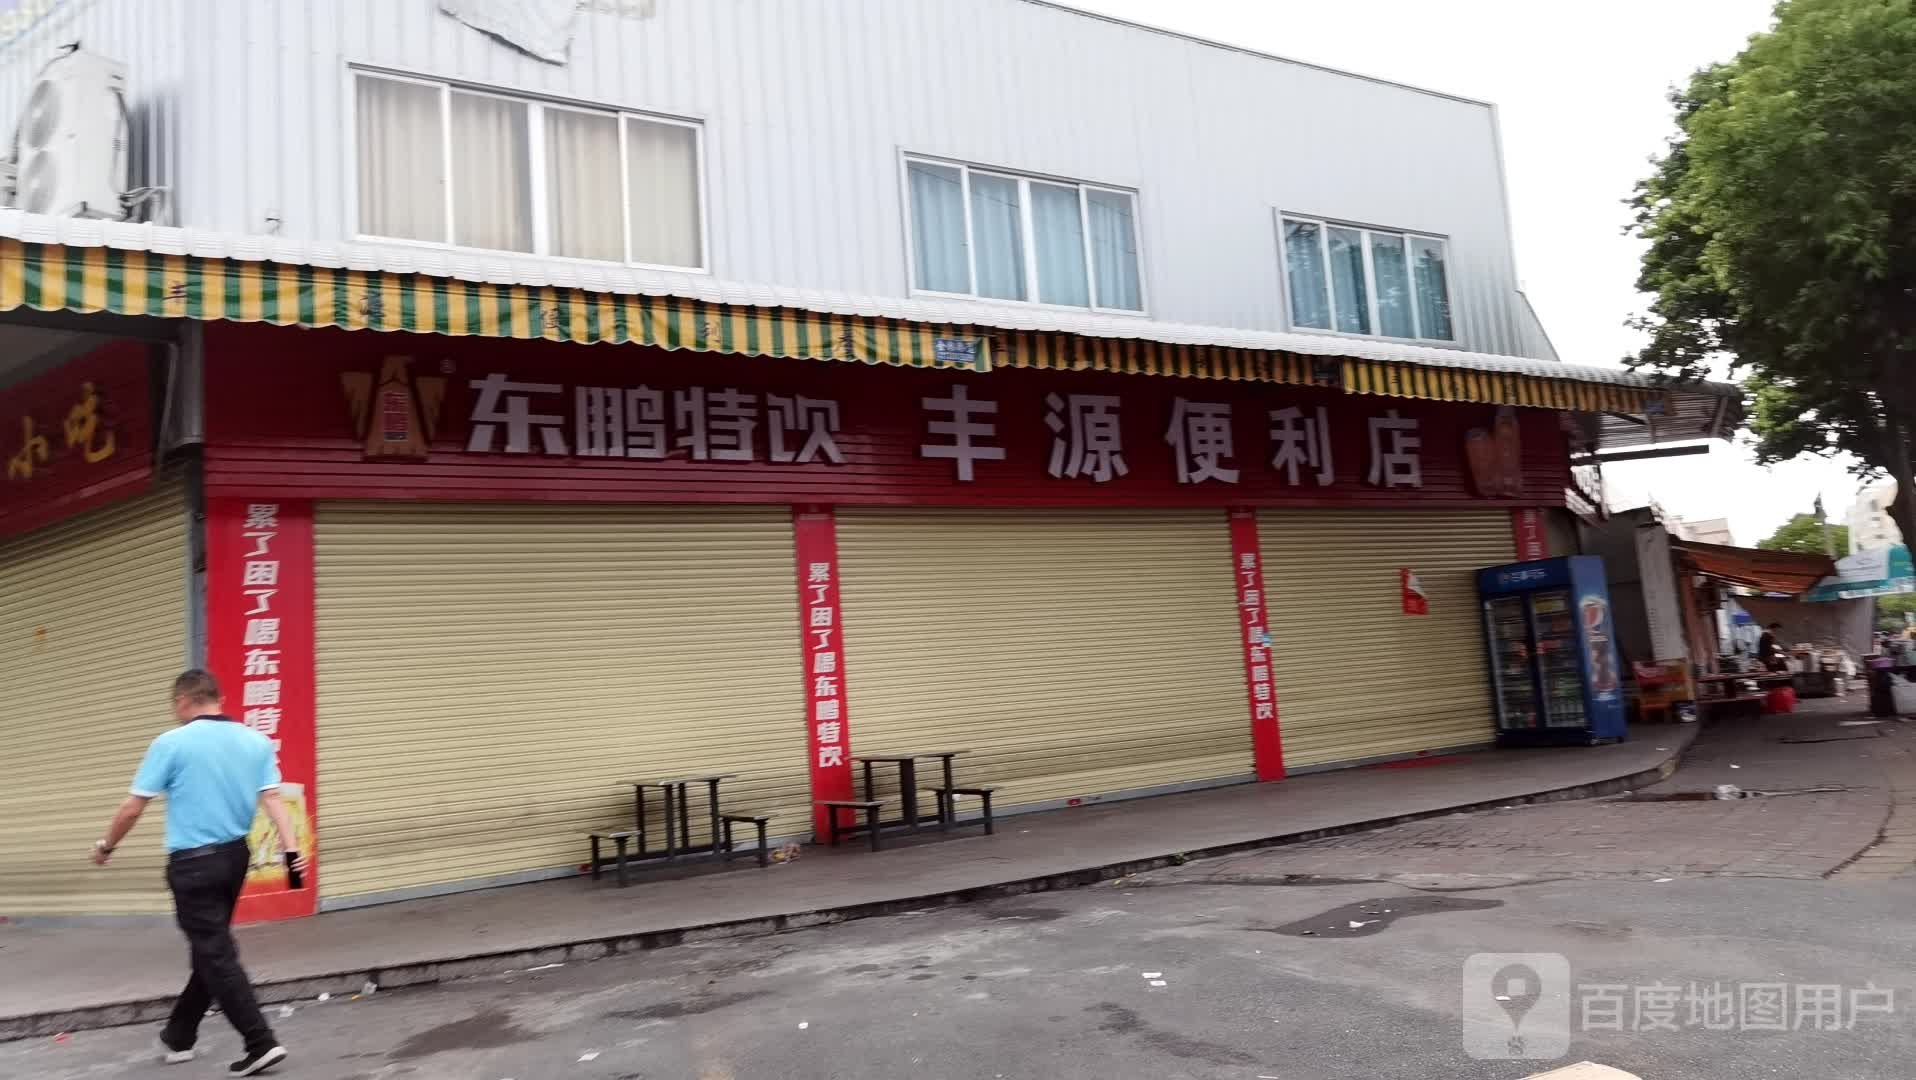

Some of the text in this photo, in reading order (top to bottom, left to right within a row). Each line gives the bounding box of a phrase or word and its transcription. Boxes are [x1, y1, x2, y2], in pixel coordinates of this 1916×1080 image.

[7, 381, 116, 480] 小吃
[465, 372, 847, 465] 东鹏特饮
[920, 385, 1425, 488] 丰源便利店
[242, 503, 282, 779] 累了困了喝东鹏特
